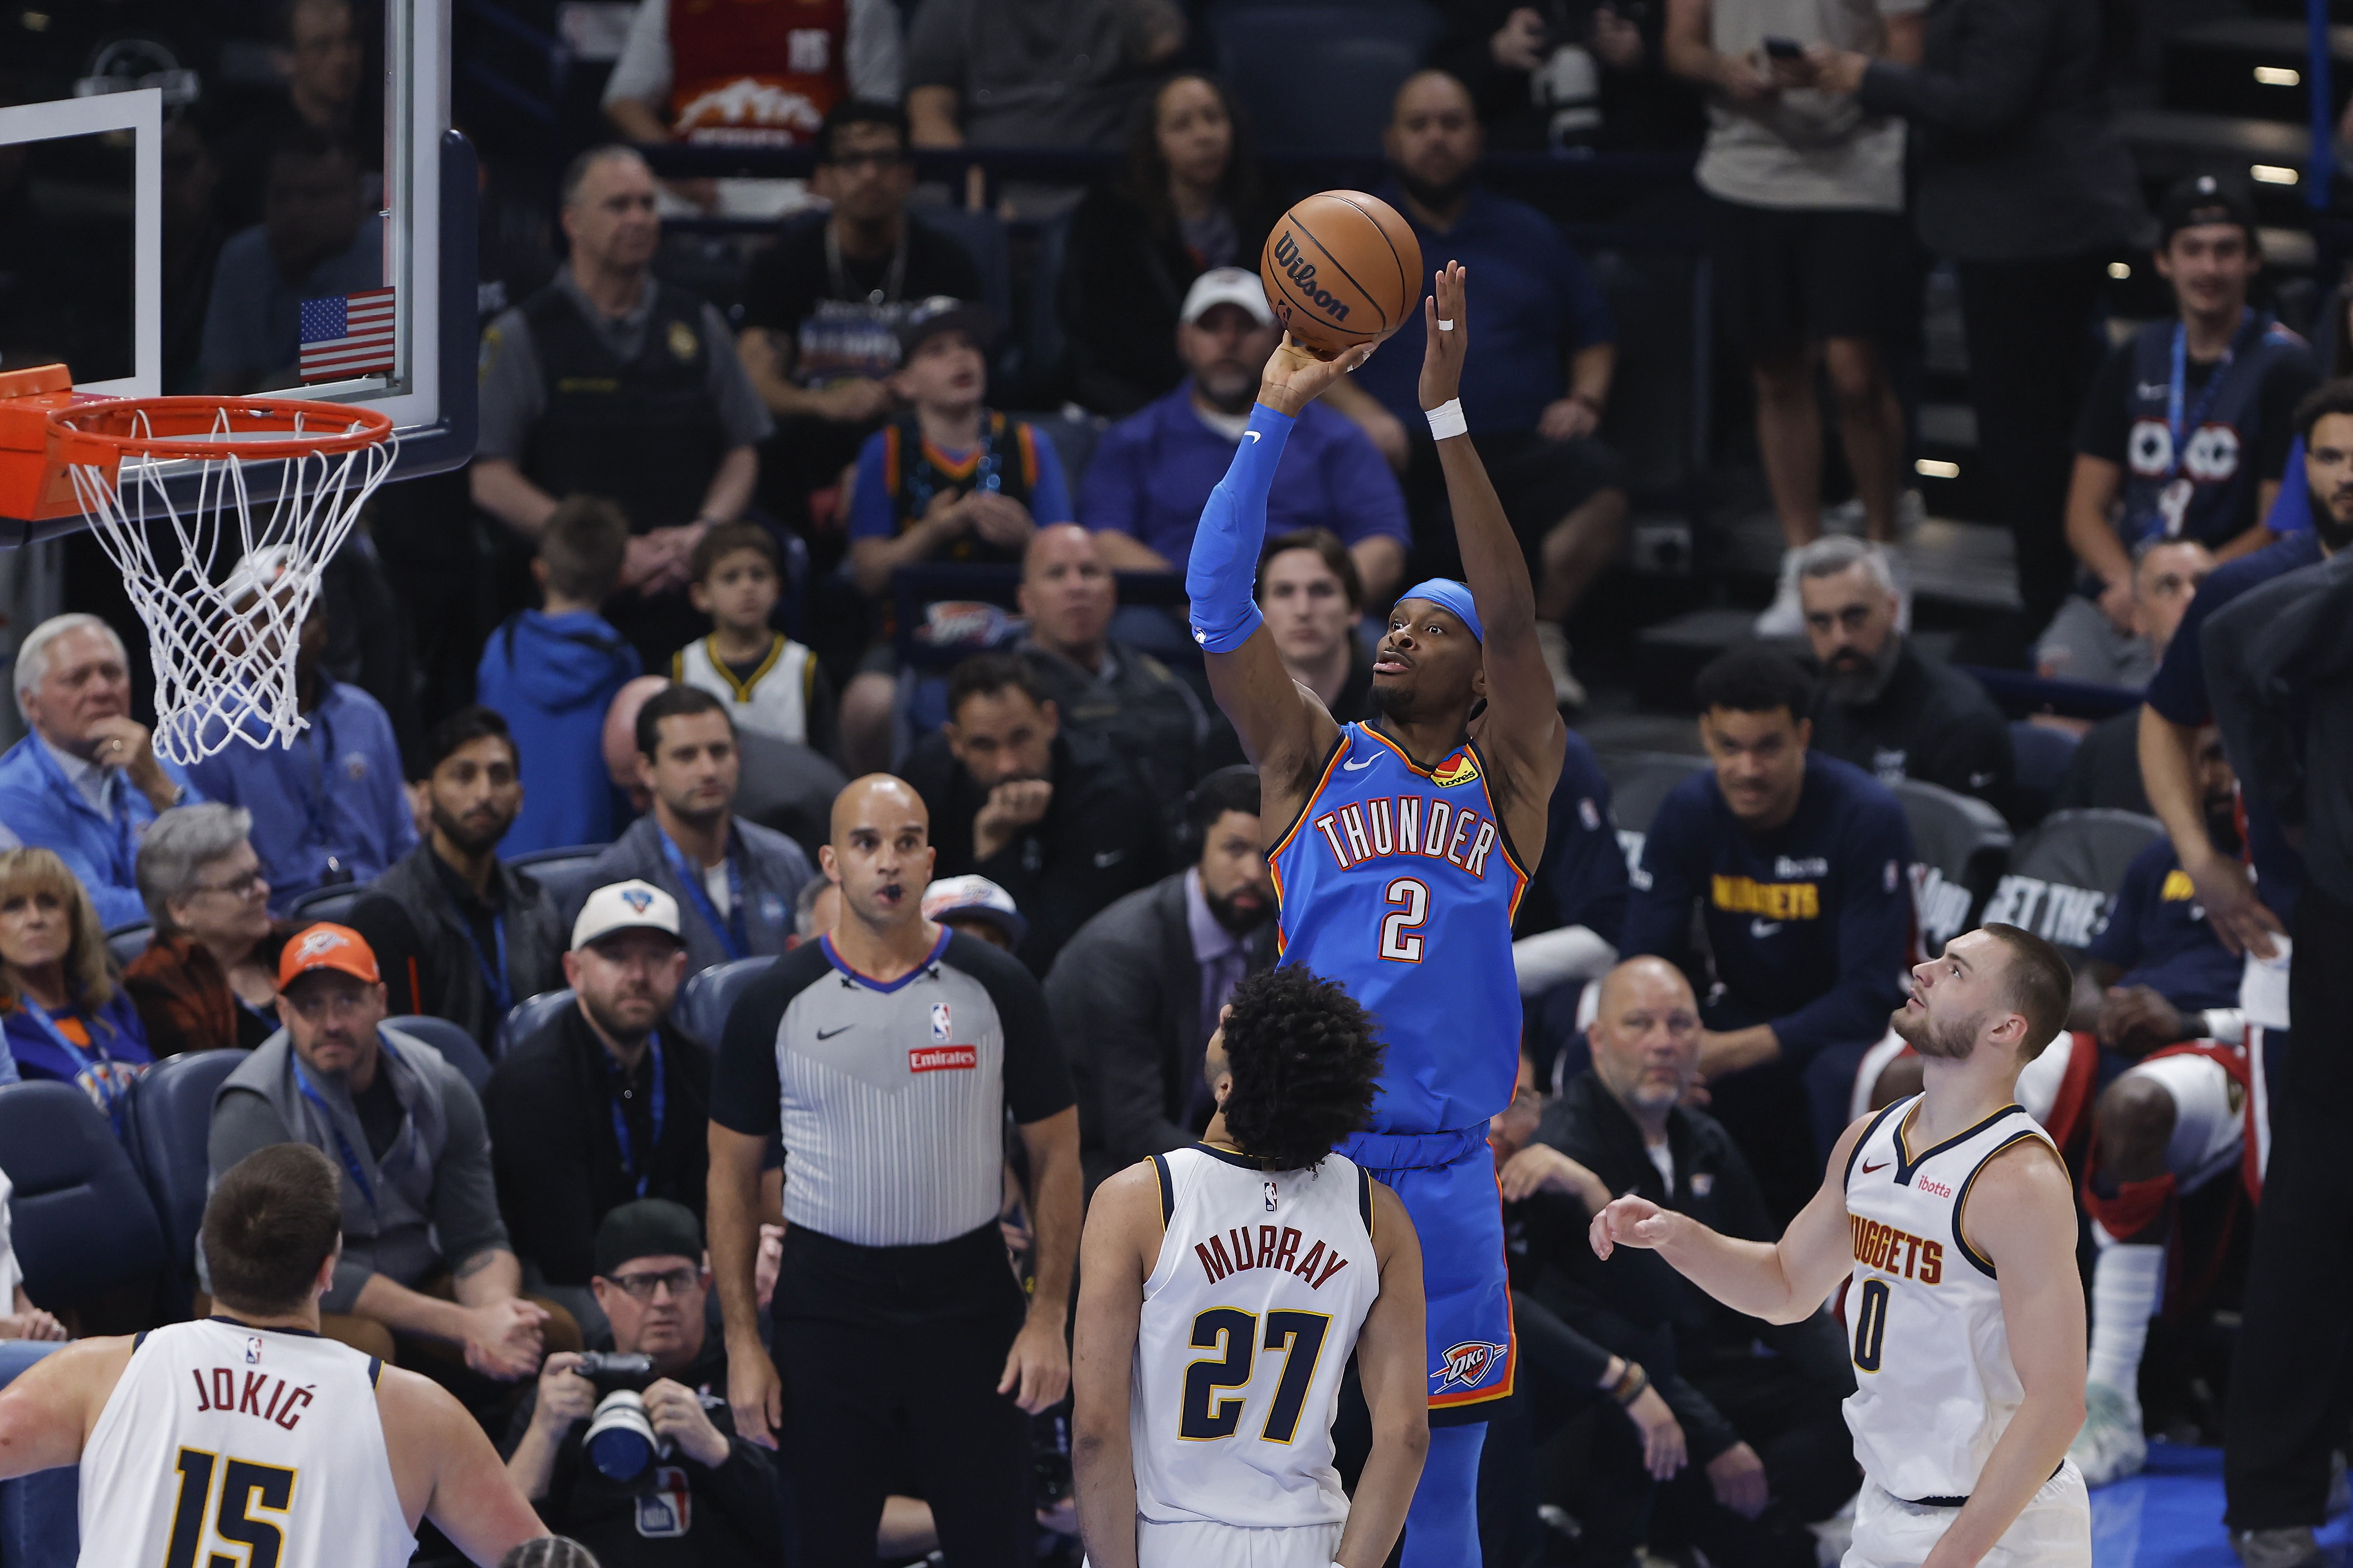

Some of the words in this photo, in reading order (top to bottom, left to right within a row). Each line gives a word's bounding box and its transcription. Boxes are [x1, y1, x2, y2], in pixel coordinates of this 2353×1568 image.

[1274, 230, 1350, 323] Wilson
[1313, 795, 1499, 881] THUNDER
[1377, 876, 1430, 964] 2
[910, 1050, 975, 1069] Emirates
[1918, 1175, 1951, 1198] ibotta
[1194, 1225, 1349, 1291] MURRAY
[1449, 1349, 1483, 1381] OKC
[1853, 1278, 1891, 1374] 0
[192, 1368, 316, 1430] JOKIĆ
[1177, 1305, 1333, 1445] 27
[164, 1445, 299, 1568] 15
